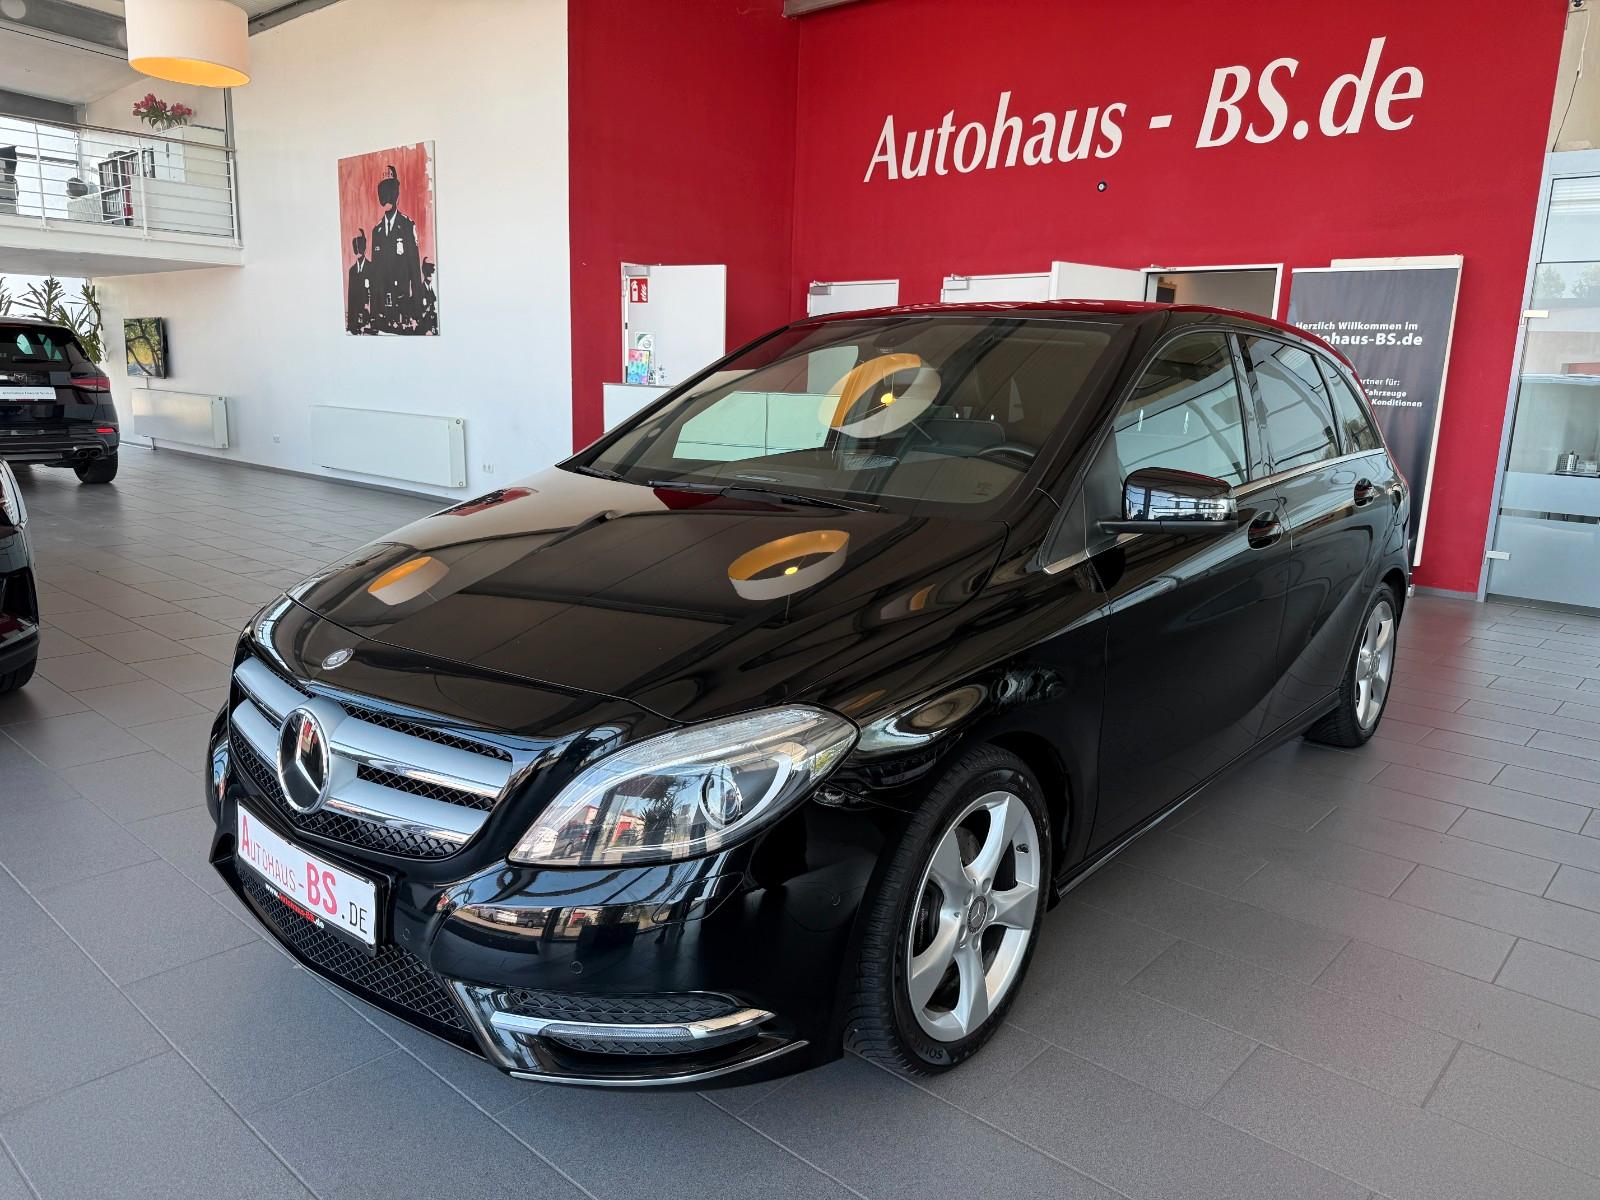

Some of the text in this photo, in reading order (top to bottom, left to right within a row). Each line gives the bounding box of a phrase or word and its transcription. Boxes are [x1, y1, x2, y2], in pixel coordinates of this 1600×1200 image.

[864, 36, 1424, 182] Autohaus - BS.de
[1295, 322, 1418, 330] Herzlich Willkommen im
[1316, 332, 1423, 345] ohaus-BS.de
[1385, 378, 1401, 386] für:
[1371, 399, 1423, 408] Konditionen
